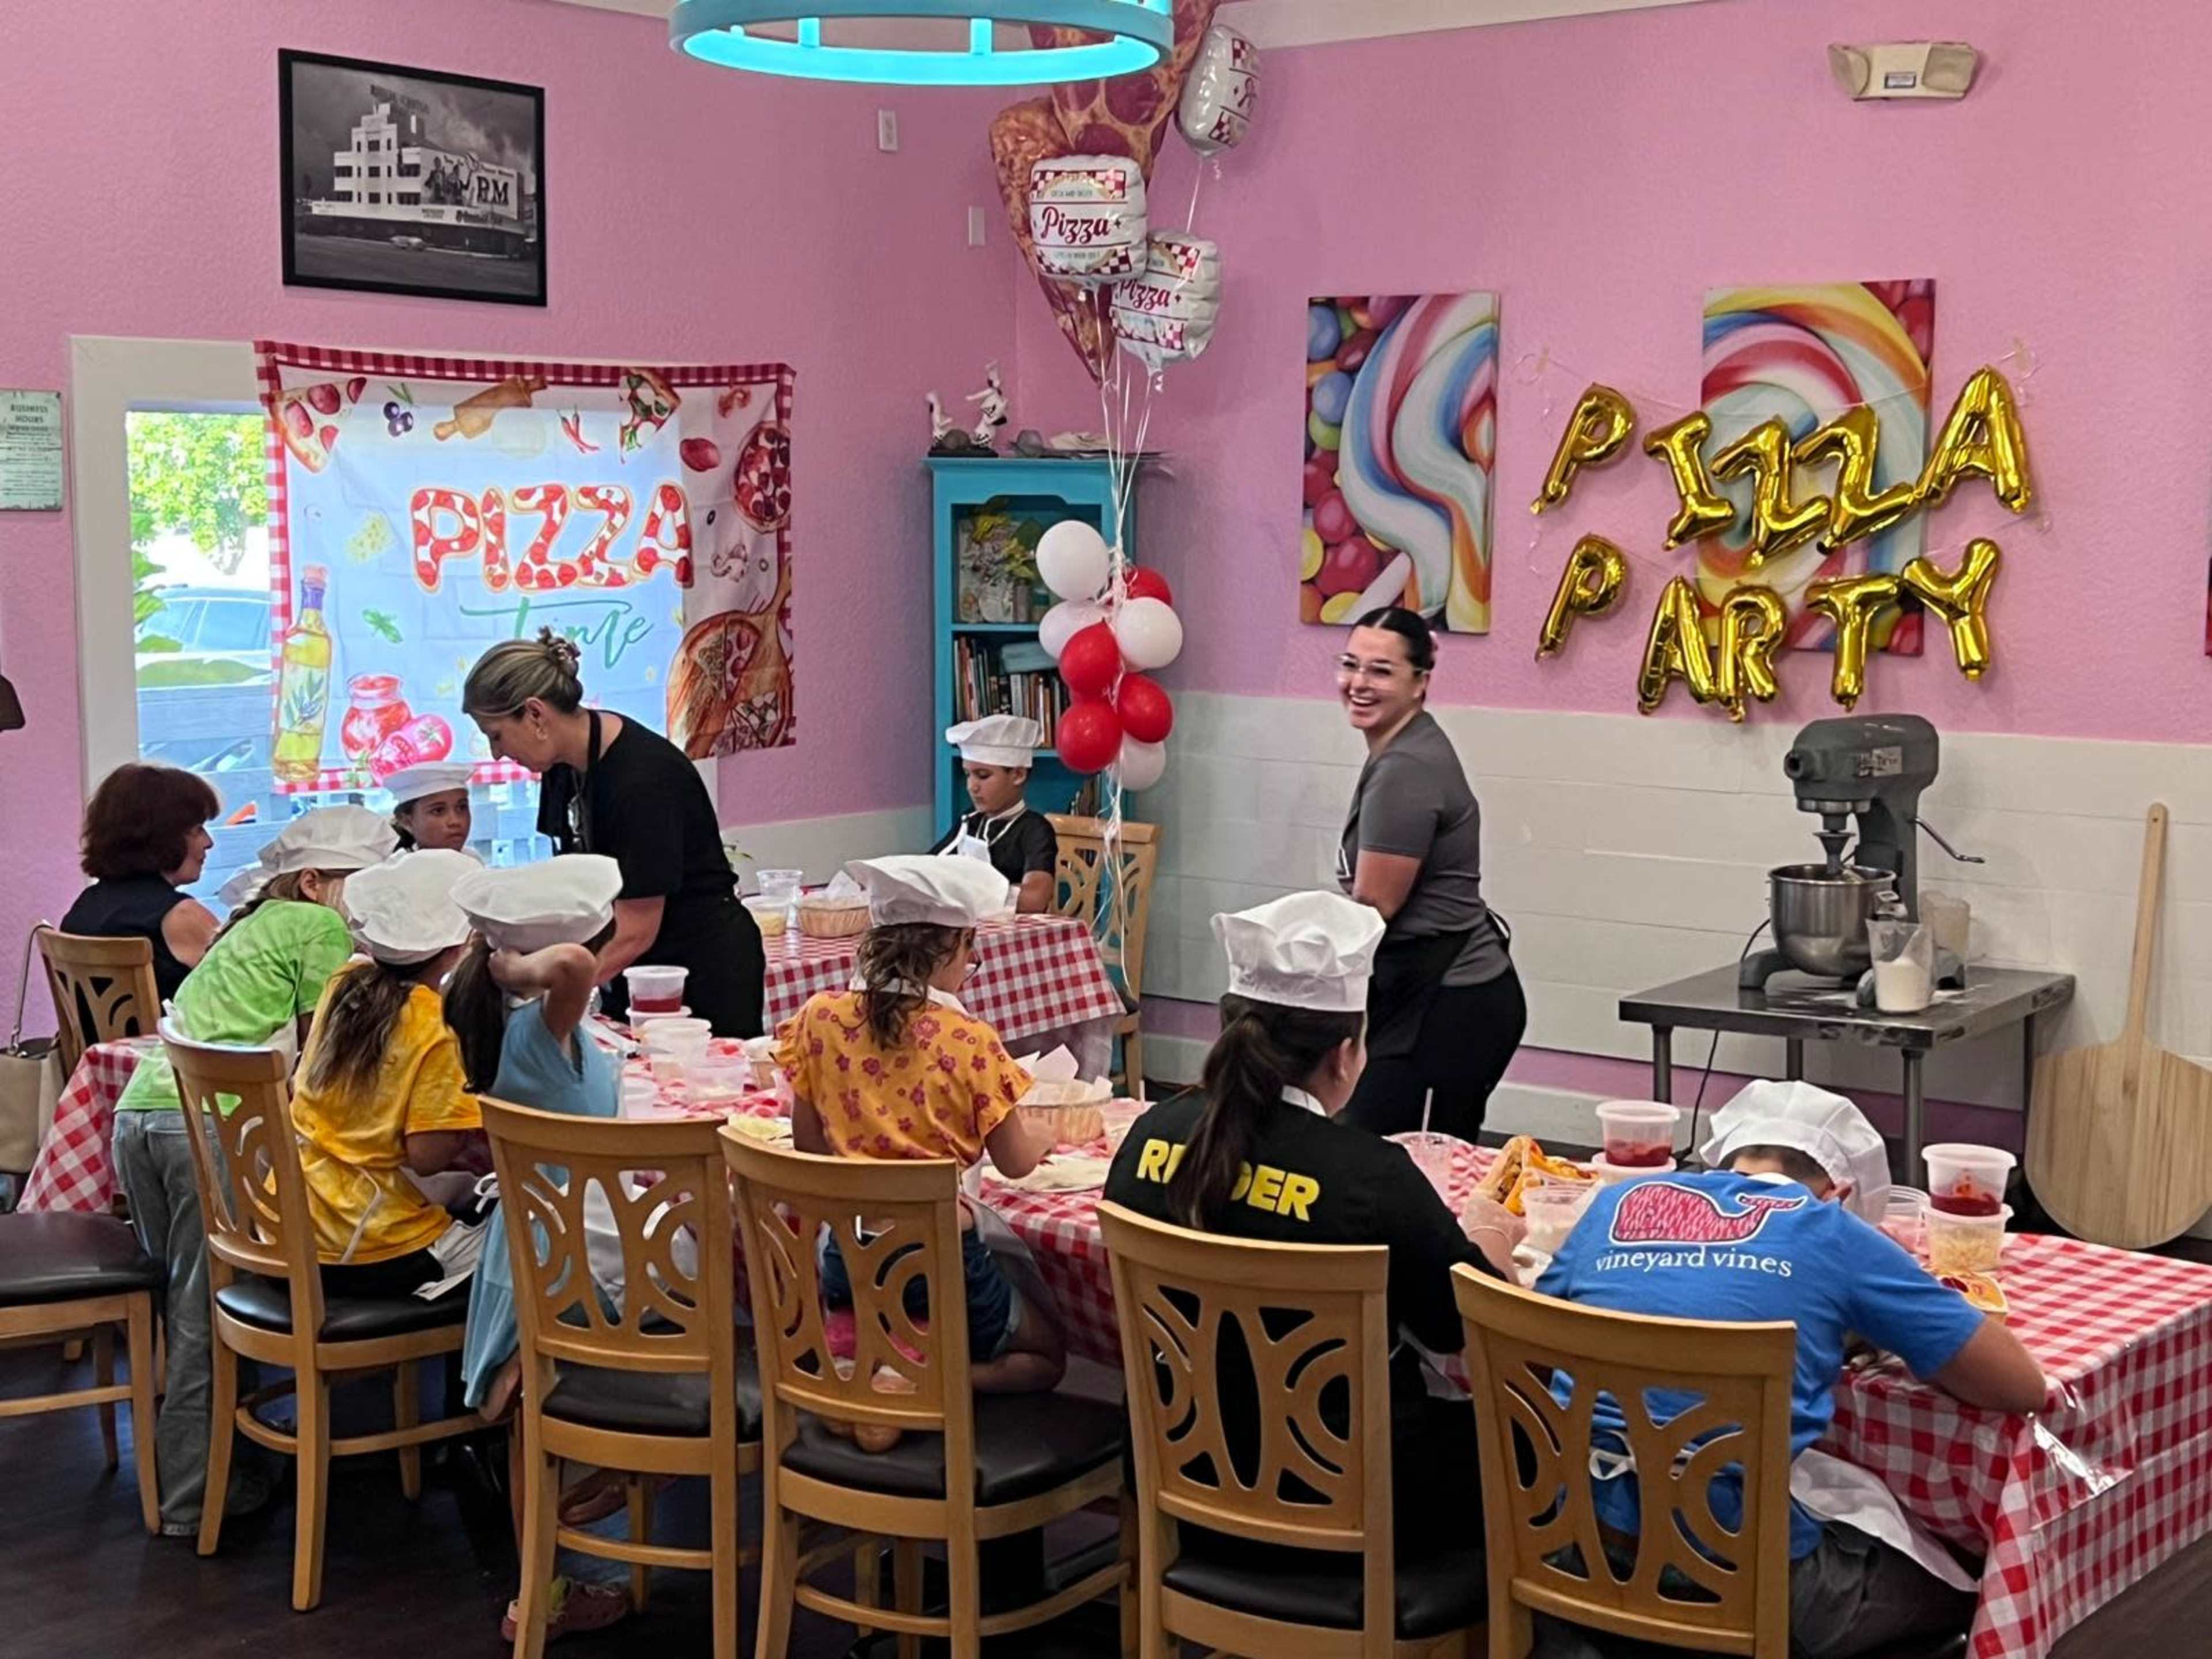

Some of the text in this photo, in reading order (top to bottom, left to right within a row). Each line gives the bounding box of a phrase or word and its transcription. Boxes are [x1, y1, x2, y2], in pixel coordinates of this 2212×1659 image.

[1040, 206, 1111, 244] Pizza
[1119, 278, 1171, 310] Pizza
[15, 415, 44, 423] HOURS
[1530, 365, 2032, 569] PIZZA
[408, 480, 695, 593] PIZZA
[460, 596, 654, 670] Tme
[1534, 533, 2000, 722] PARTY
[1136, 1138, 1320, 1222] RDER
[1596, 1245, 1793, 1277] vineyard vines
